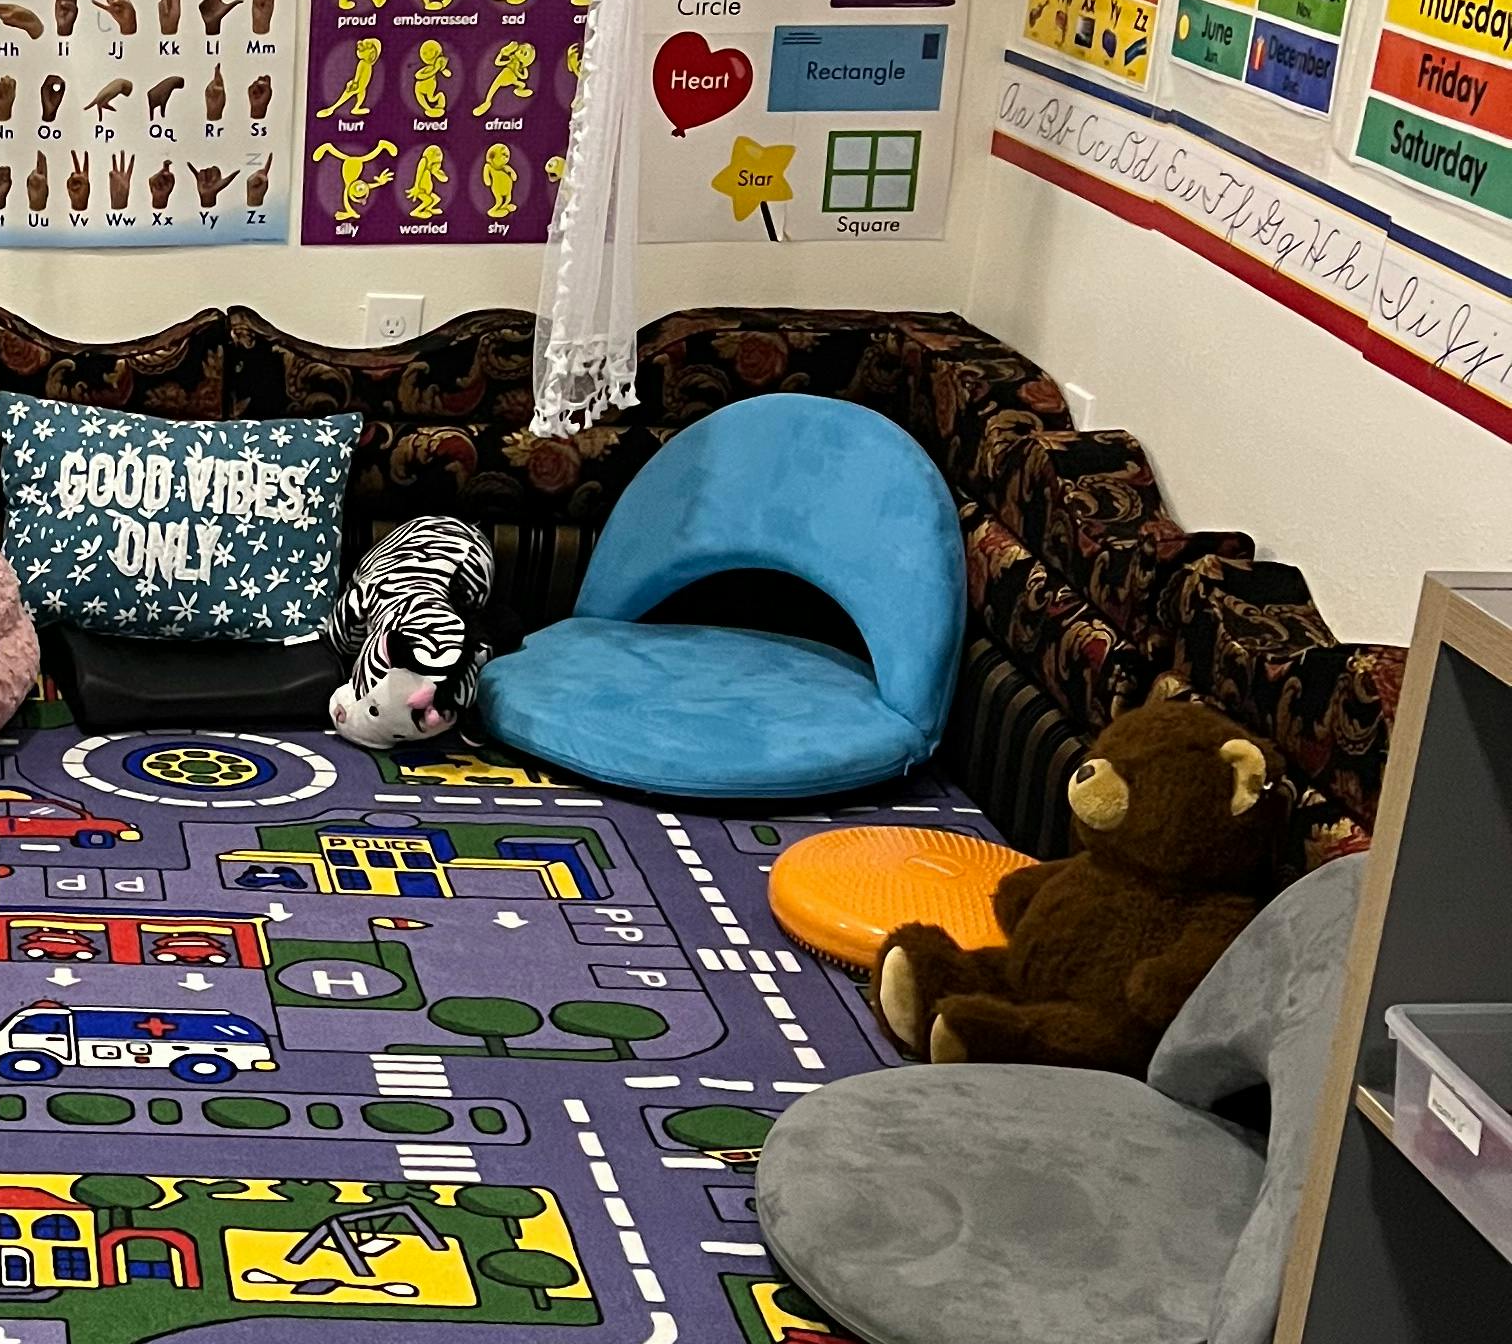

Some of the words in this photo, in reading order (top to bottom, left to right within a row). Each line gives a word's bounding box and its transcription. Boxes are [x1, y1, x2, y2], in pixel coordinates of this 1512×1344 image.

[337, 13, 377, 28] proud
[393, 12, 478, 26] embarrassed
[501, 12, 526, 25] sad
[1201, 14, 1233, 46] June
[1268, 35, 1331, 79] December
[670, 69, 730, 90] Heart
[806, 61, 907, 87] Rectangle
[1416, 53, 1489, 117] Friday
[413, 118, 448, 131] loved
[485, 118, 523, 131] afraid
[1390, 119, 1488, 197] Saturday
[737, 170, 774, 187] Star
[399, 222, 448, 235] worried
[836, 215, 901, 238] Square
[57, 453, 175, 513] GOOD
[187, 454, 308, 521] VIBES
[114, 516, 224, 588] ONLY
[329, 838, 425, 852] POLICE
